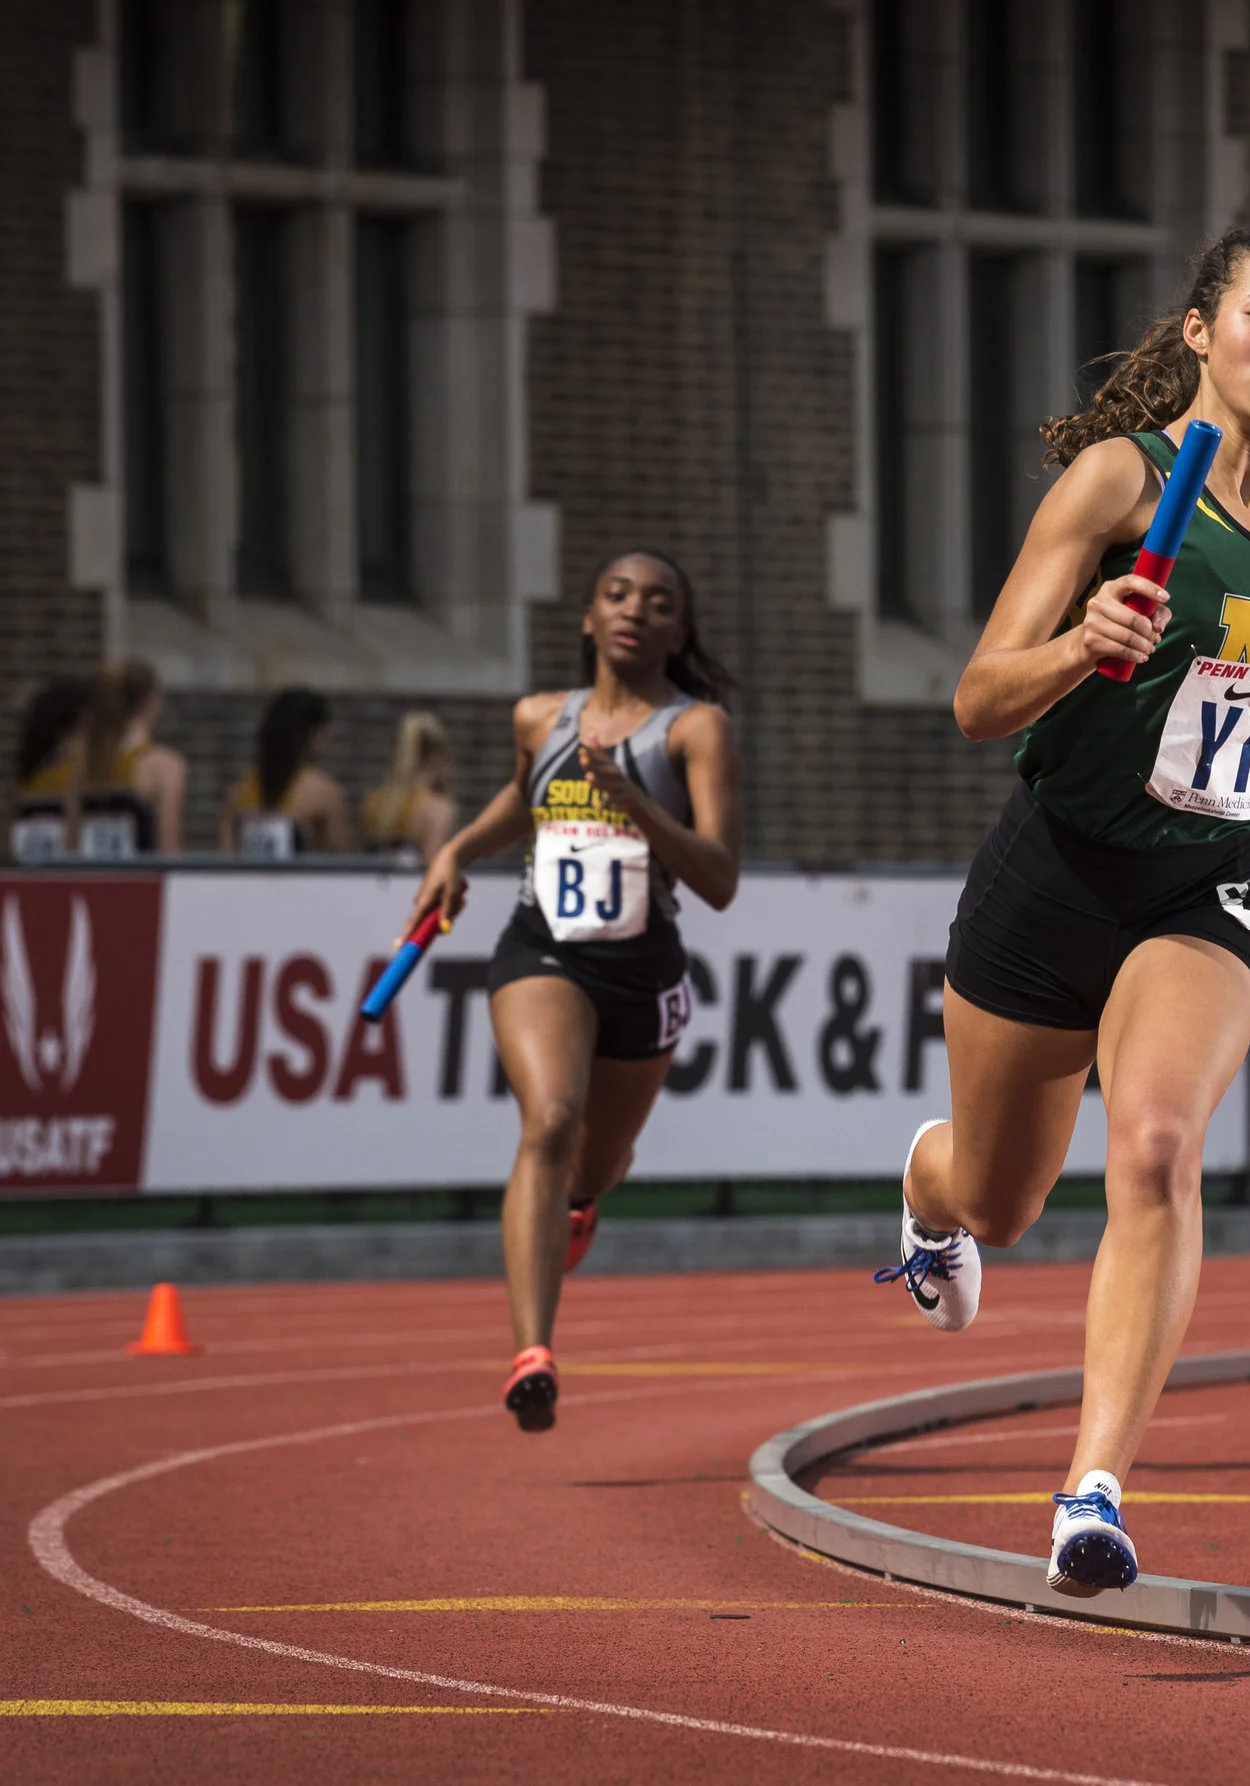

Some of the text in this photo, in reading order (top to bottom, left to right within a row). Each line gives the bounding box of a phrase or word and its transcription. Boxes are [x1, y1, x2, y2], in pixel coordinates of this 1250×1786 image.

[1198, 661, 1250, 680] PENN
[1188, 792, 1216, 807] Penn
[558, 859, 622, 921] BJ
